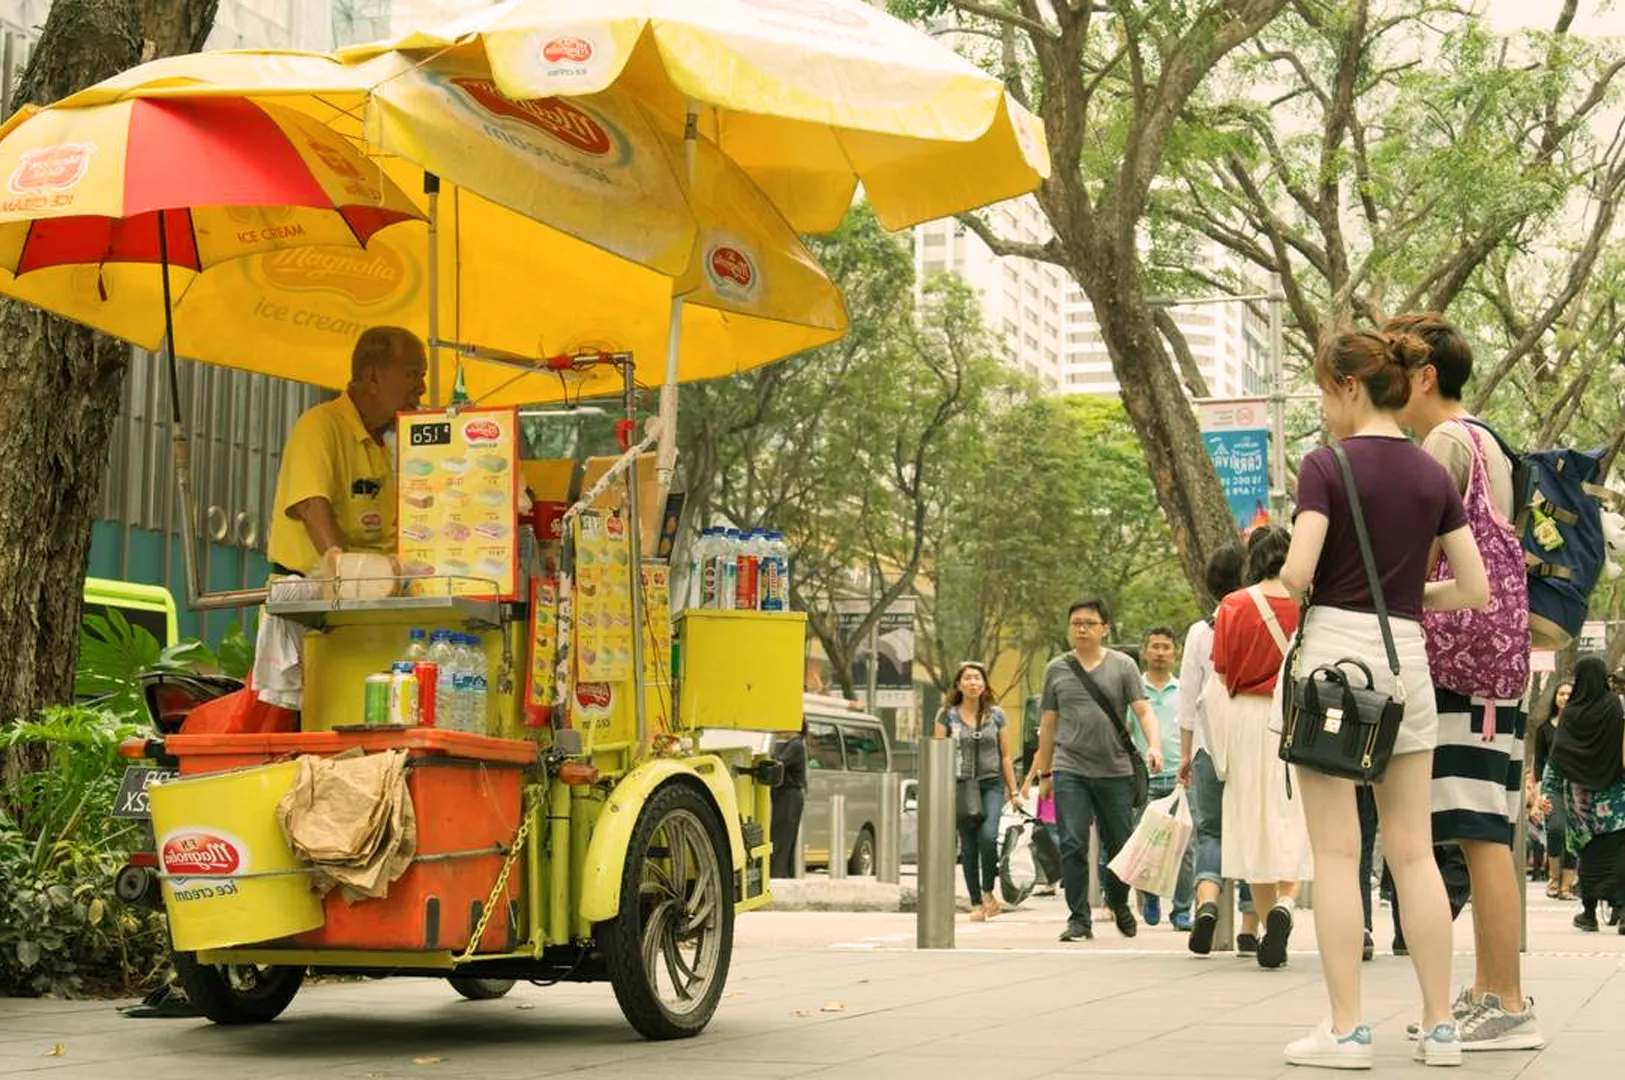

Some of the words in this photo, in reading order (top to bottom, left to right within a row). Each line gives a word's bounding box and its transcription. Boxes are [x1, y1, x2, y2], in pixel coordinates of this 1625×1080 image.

[237, 231, 259, 244] ICE
[261, 224, 306, 240] CREAM
[253, 297, 290, 321] ice
